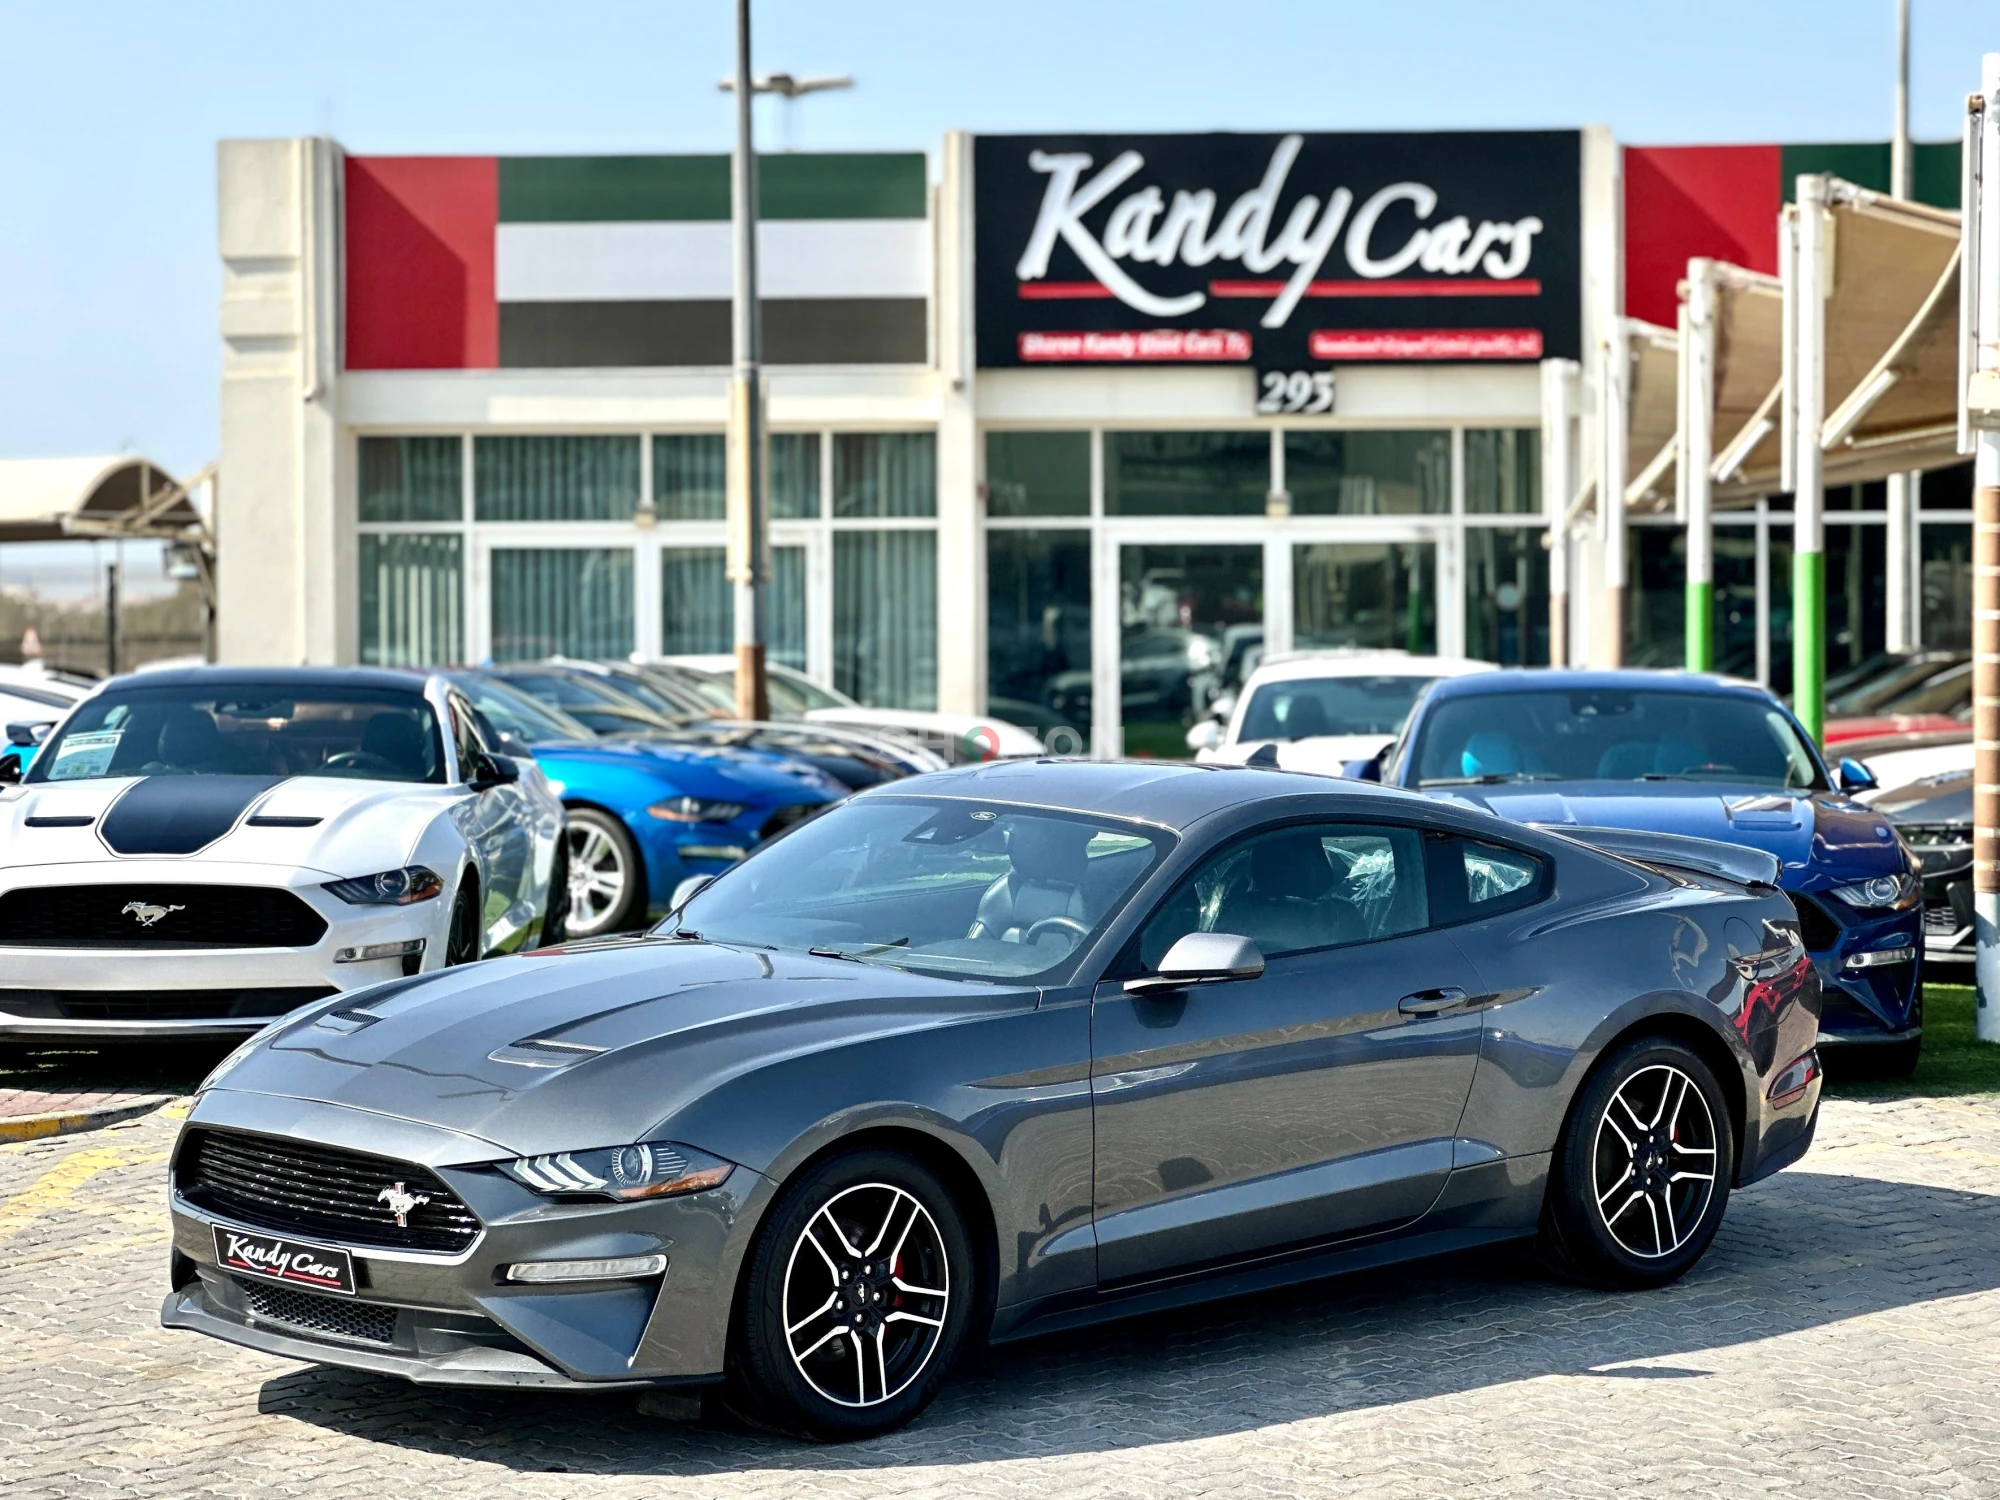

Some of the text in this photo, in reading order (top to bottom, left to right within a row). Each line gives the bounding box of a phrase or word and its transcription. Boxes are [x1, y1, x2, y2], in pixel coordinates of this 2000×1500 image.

[1015, 133, 1543, 328] Kandy Cars
[1256, 369, 1335, 414] 295
[226, 1233, 339, 1278] Kandy Cars
